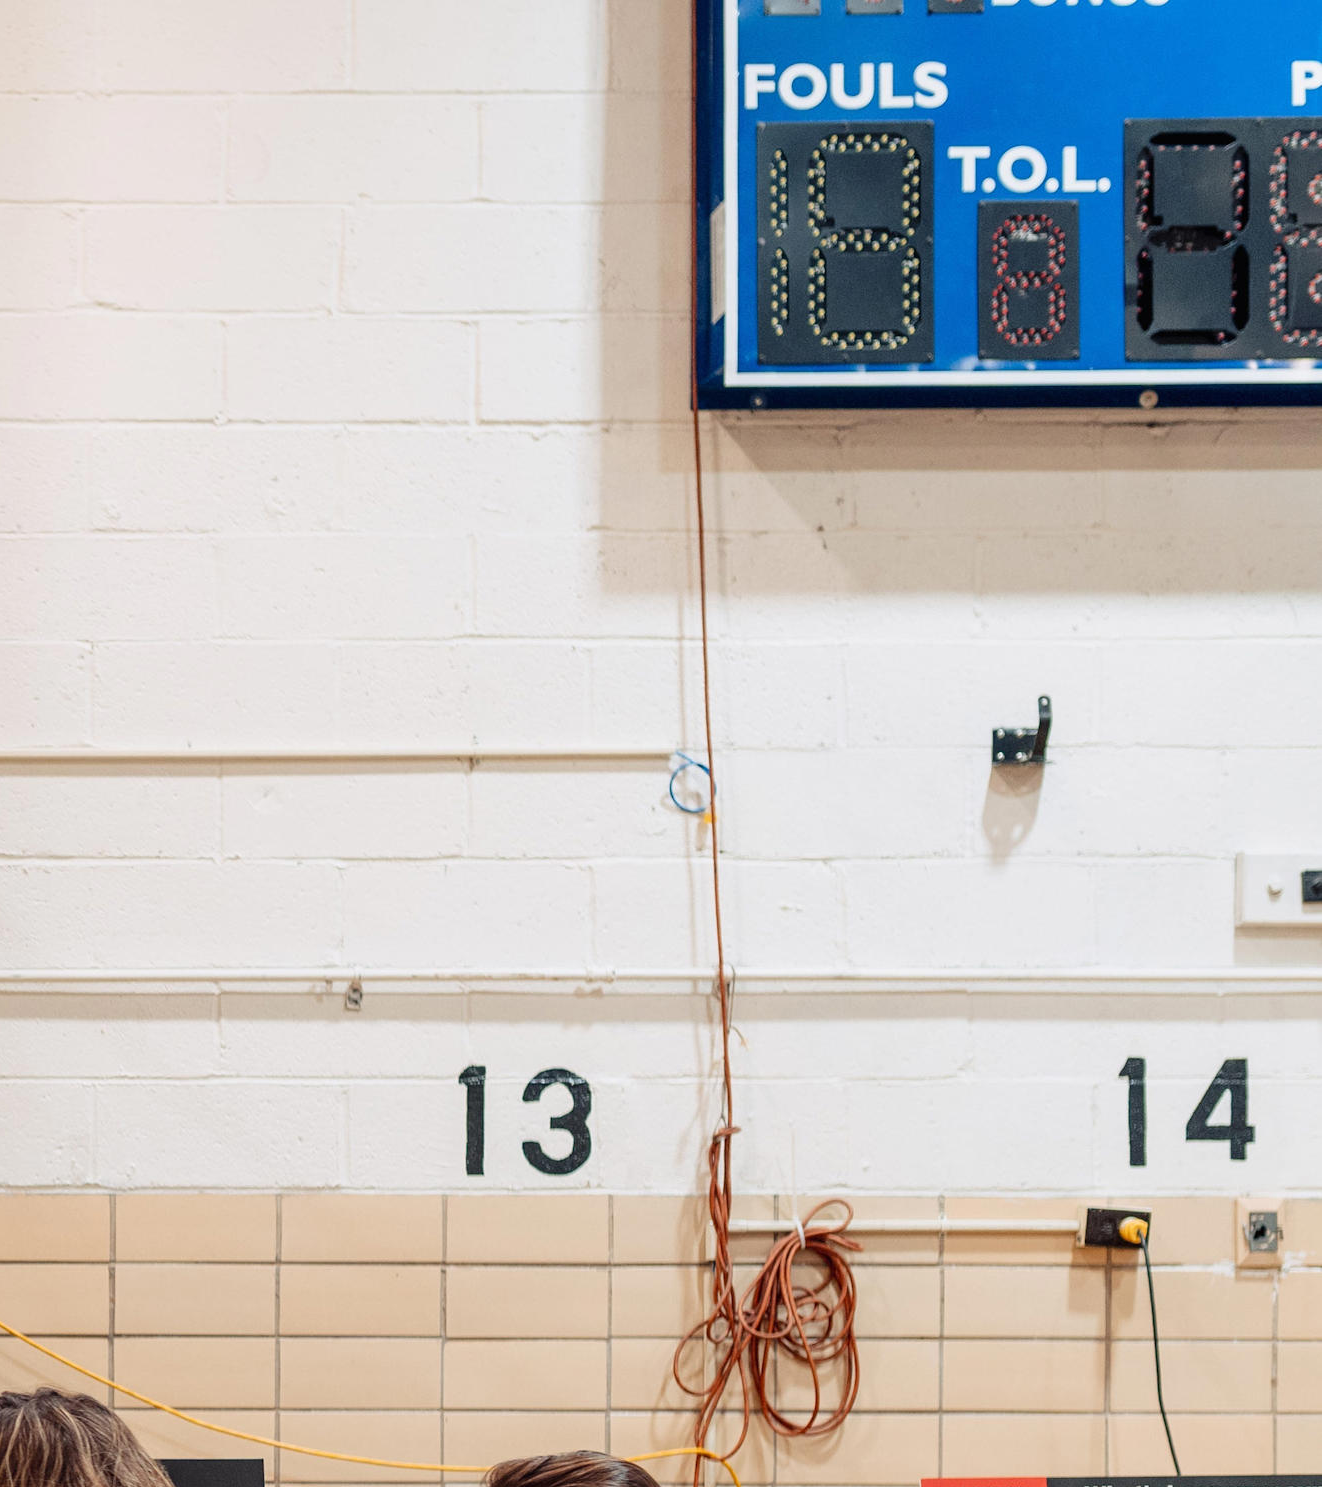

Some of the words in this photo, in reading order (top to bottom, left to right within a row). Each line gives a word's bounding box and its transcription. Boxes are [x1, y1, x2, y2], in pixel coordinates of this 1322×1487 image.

[745, 61, 948, 109] FOULS
[948, 145, 1111, 193] T.O.L.
[458, 1065, 593, 1175] 13
[1119, 1057, 1255, 1167] 14
